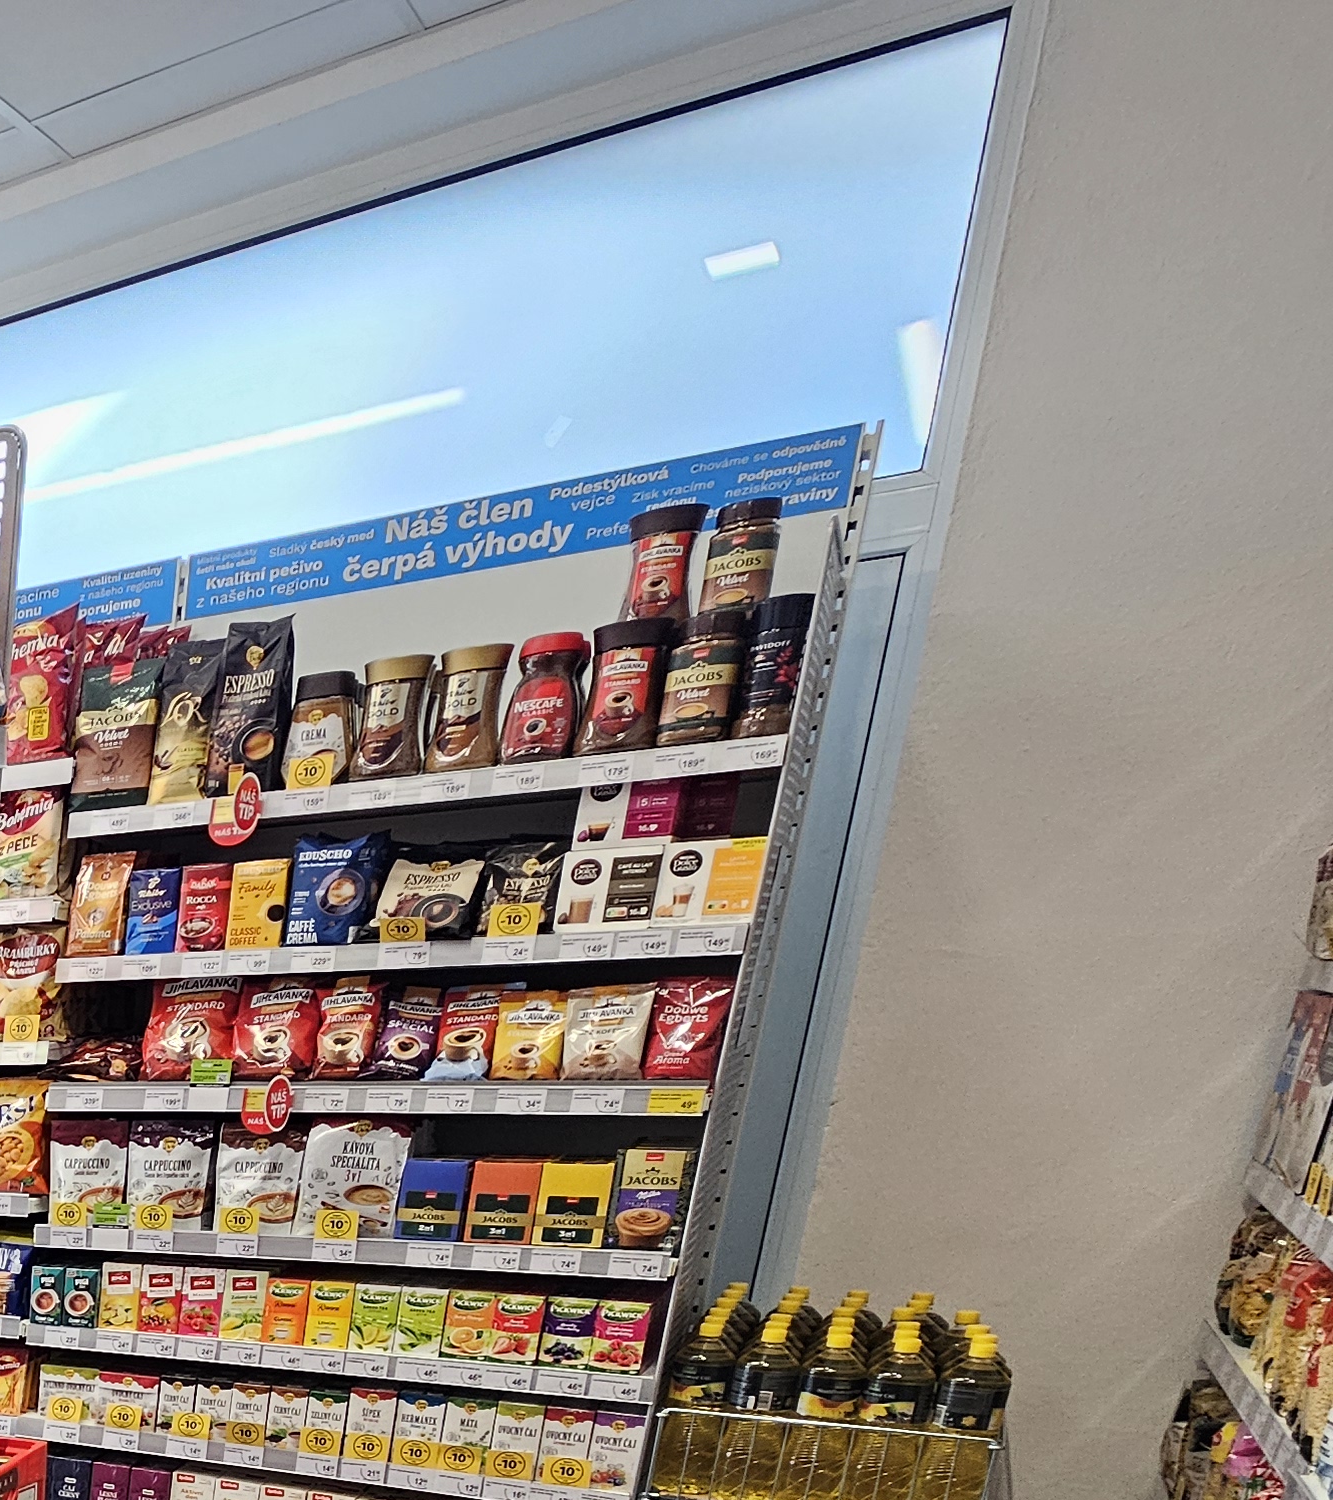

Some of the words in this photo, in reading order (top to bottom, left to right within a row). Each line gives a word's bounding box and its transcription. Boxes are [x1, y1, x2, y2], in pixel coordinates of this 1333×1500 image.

[689, 455, 749, 475] Chováme
[753, 451, 769, 462] se
[771, 436, 848, 459] odpovědně
[737, 457, 833, 484] Podporujeme
[549, 465, 670, 501] Podestýlková
[661, 479, 715, 497] vracíme
[724, 477, 793, 500] neziskový
[795, 468, 842, 488] sektor
[570, 493, 616, 512] vejce
[384, 508, 449, 543] Náš
[452, 496, 534, 532] člen
[269, 541, 308, 559] Sladký
[310, 535, 345, 553] český
[347, 528, 375, 545] med
[342, 544, 436, 584] čerpá
[444, 521, 576, 569] výhody
[711, 555, 762, 575] JACOBS
[83, 571, 122, 589] Kvalitní
[123, 564, 163, 582] uzeniny
[205, 571, 267, 592] Kvalitní
[269, 559, 323, 582] pečivo
[209, 587, 265, 606] našeho
[271, 575, 330, 597] regionu
[223, 668, 275, 694] ESPRESSO
[671, 667, 724, 688] JACOBS
[90, 710, 143, 730] JACOBS
[521, 707, 555, 718] CLASSIC
[300, 727, 328, 743] CREMA
[238, 787, 259, 804] NÁŠ
[238, 803, 257, 821] TIP
[298, 848, 353, 863] EDUSCHO
[237, 880, 276, 897] Family
[131, 897, 173, 912] Exclusive
[186, 894, 218, 905] ROCCA
[230, 925, 262, 939] CLASSIC
[286, 931, 318, 945] CREMA
[229, 935, 258, 947] COFFEE
[165, 977, 239, 997] JIHLAVANKA
[254, 987, 312, 1006] JIHLAVANKA
[322, 992, 375, 1008] JIHLAVANKA
[165, 1000, 226, 1013] STANDARD
[663, 1003, 709, 1016] Douwe
[252, 1010, 302, 1024] STANDARD
[445, 1012, 500, 1025] STANDARD
[658, 1011, 709, 1025] Egberts
[386, 1019, 435, 1034] SPECIAL
[270, 1088, 288, 1104] NÁŠ
[270, 1103, 287, 1120] TIP
[342, 1139, 375, 1156] KÁVOVÁ
[64, 1156, 111, 1170] CAPPUCCINO
[143, 1158, 193, 1173] CAPPUCCINO
[234, 1160, 284, 1175] CAPPUCCINO
[331, 1154, 381, 1171] SPECIALITA
[625, 1174, 678, 1187] JACOBS
[411, 1210, 446, 1223] JACOBS
[481, 1213, 518, 1226] JACOBS
[551, 1216, 589, 1228] JACOBS
